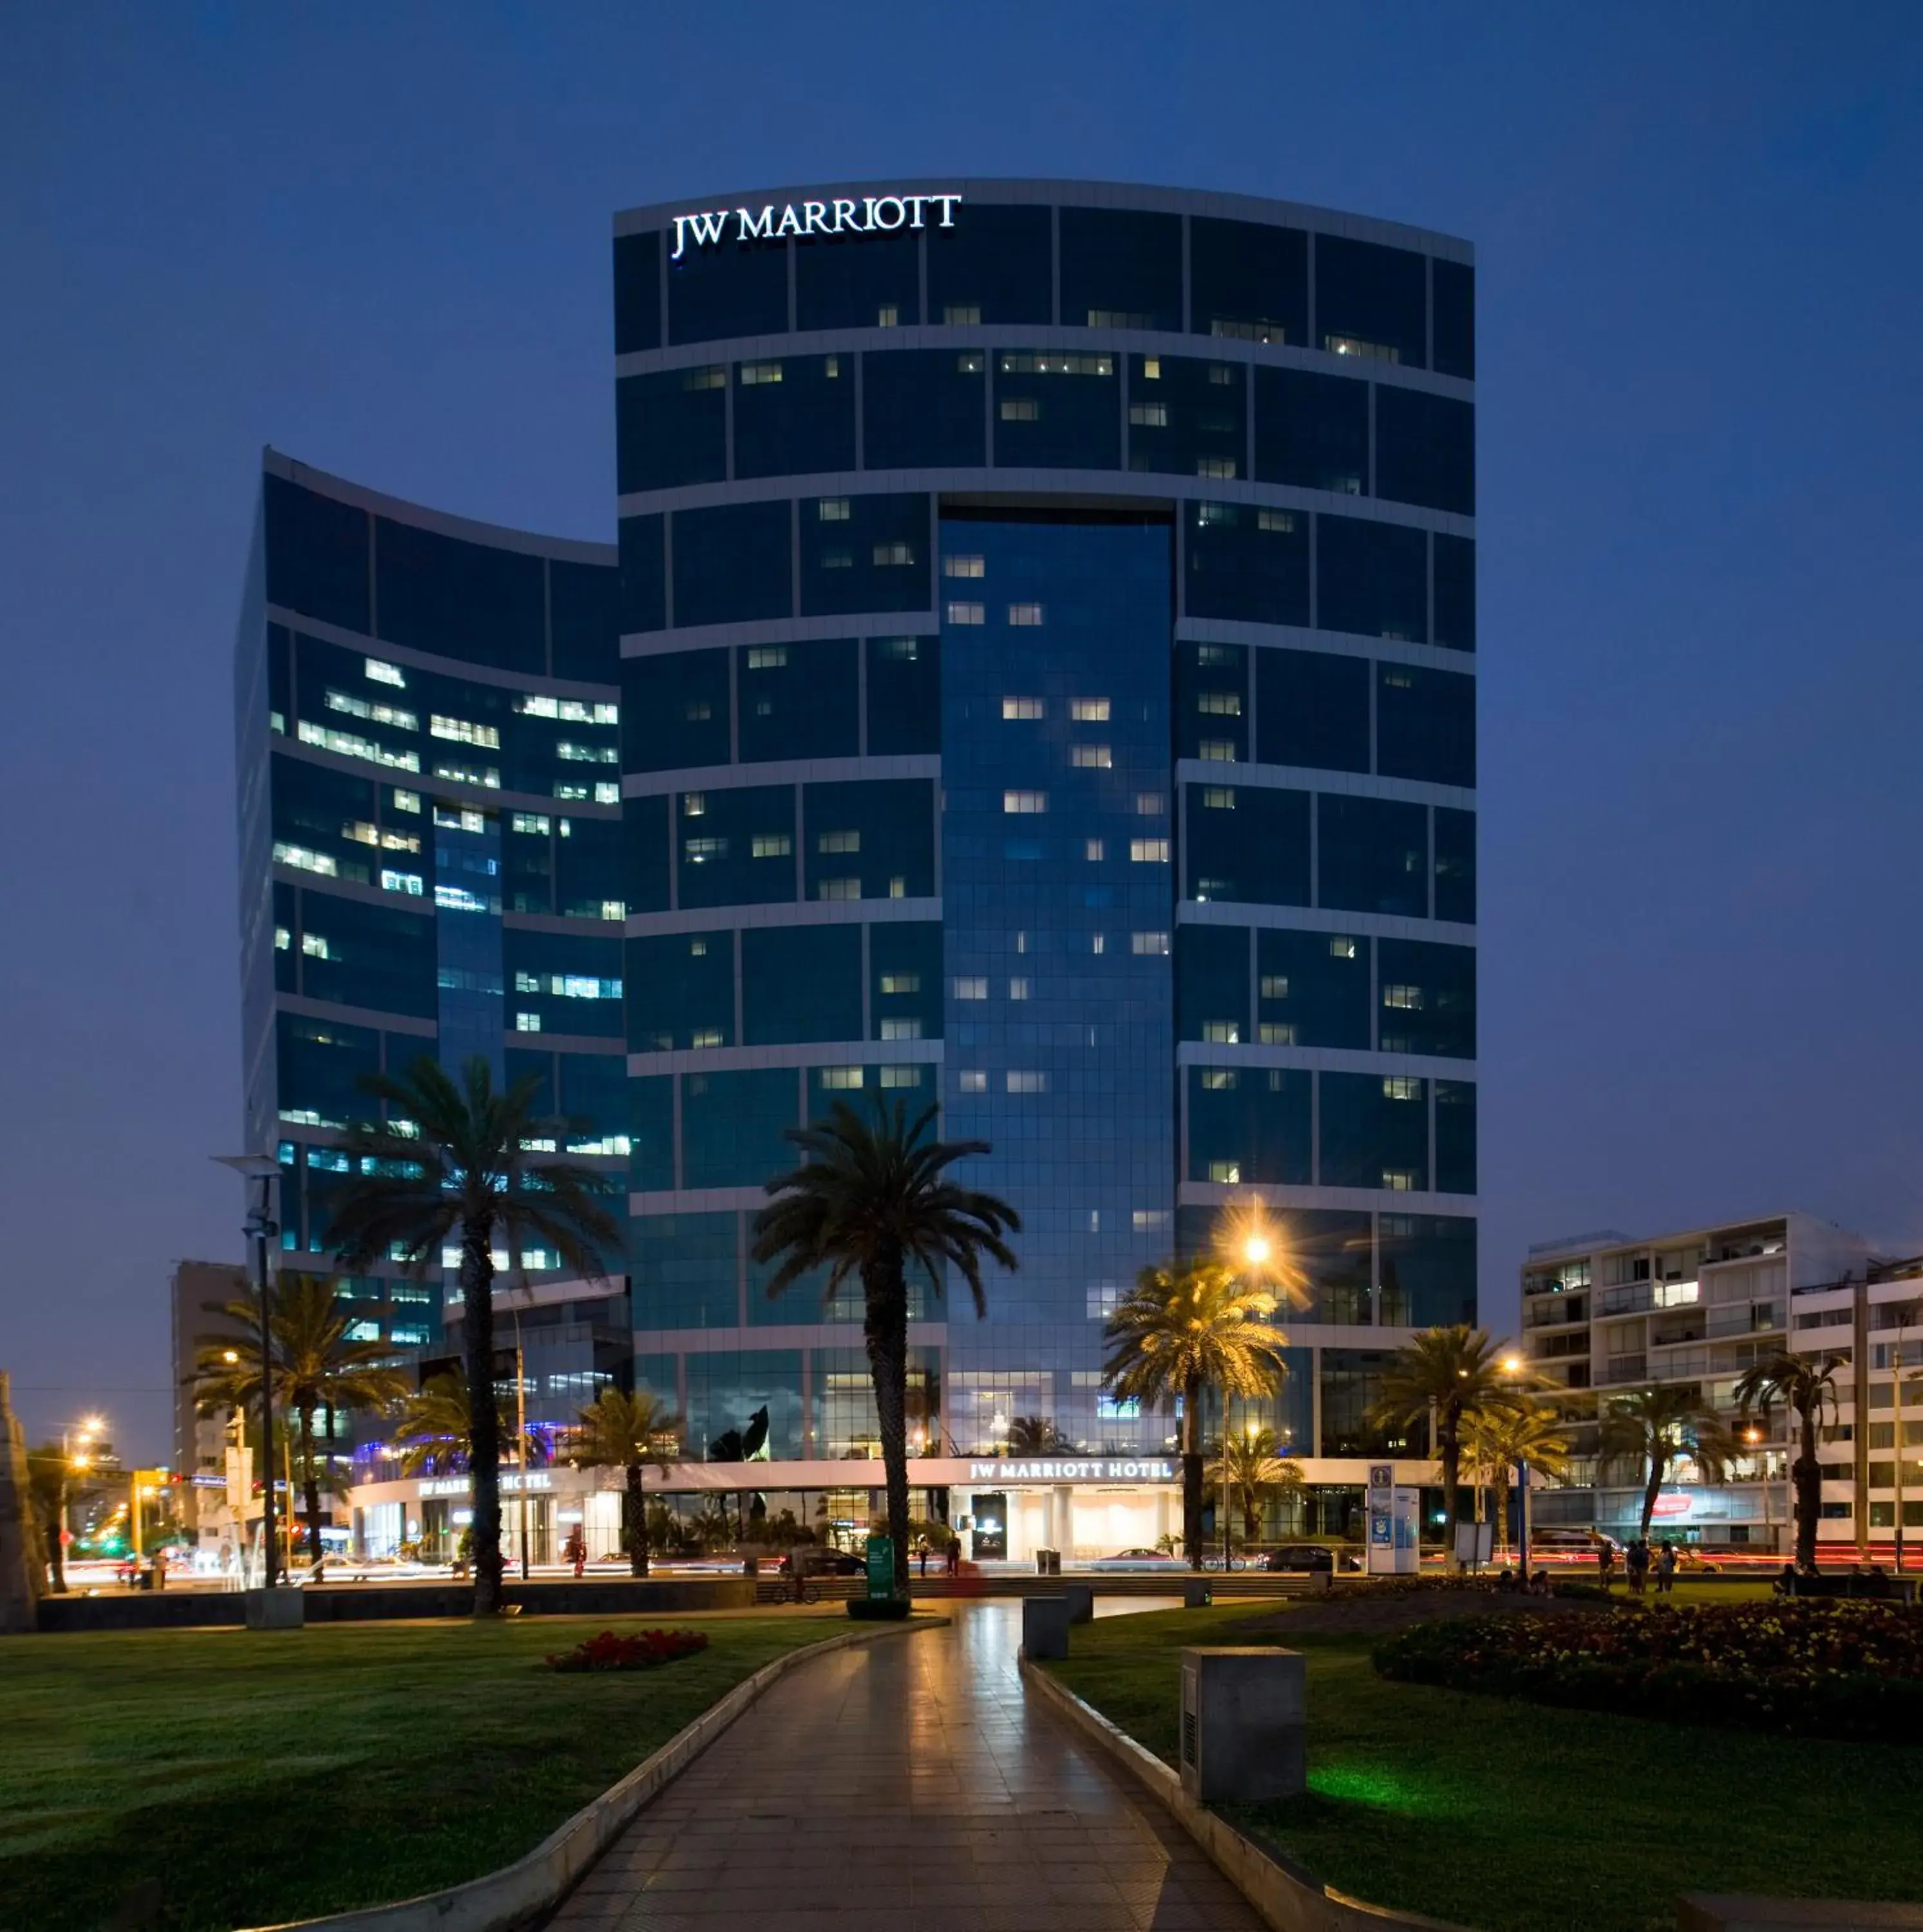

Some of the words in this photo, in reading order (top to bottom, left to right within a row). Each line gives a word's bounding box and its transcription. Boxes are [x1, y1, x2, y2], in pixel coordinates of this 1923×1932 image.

[672, 211, 728, 259] JW
[736, 195, 962, 240] MARRIOTT
[970, 1463, 996, 1479] JW
[1000, 1462, 1103, 1477] MARRIOTT
[1108, 1462, 1171, 1477] HOTEL
